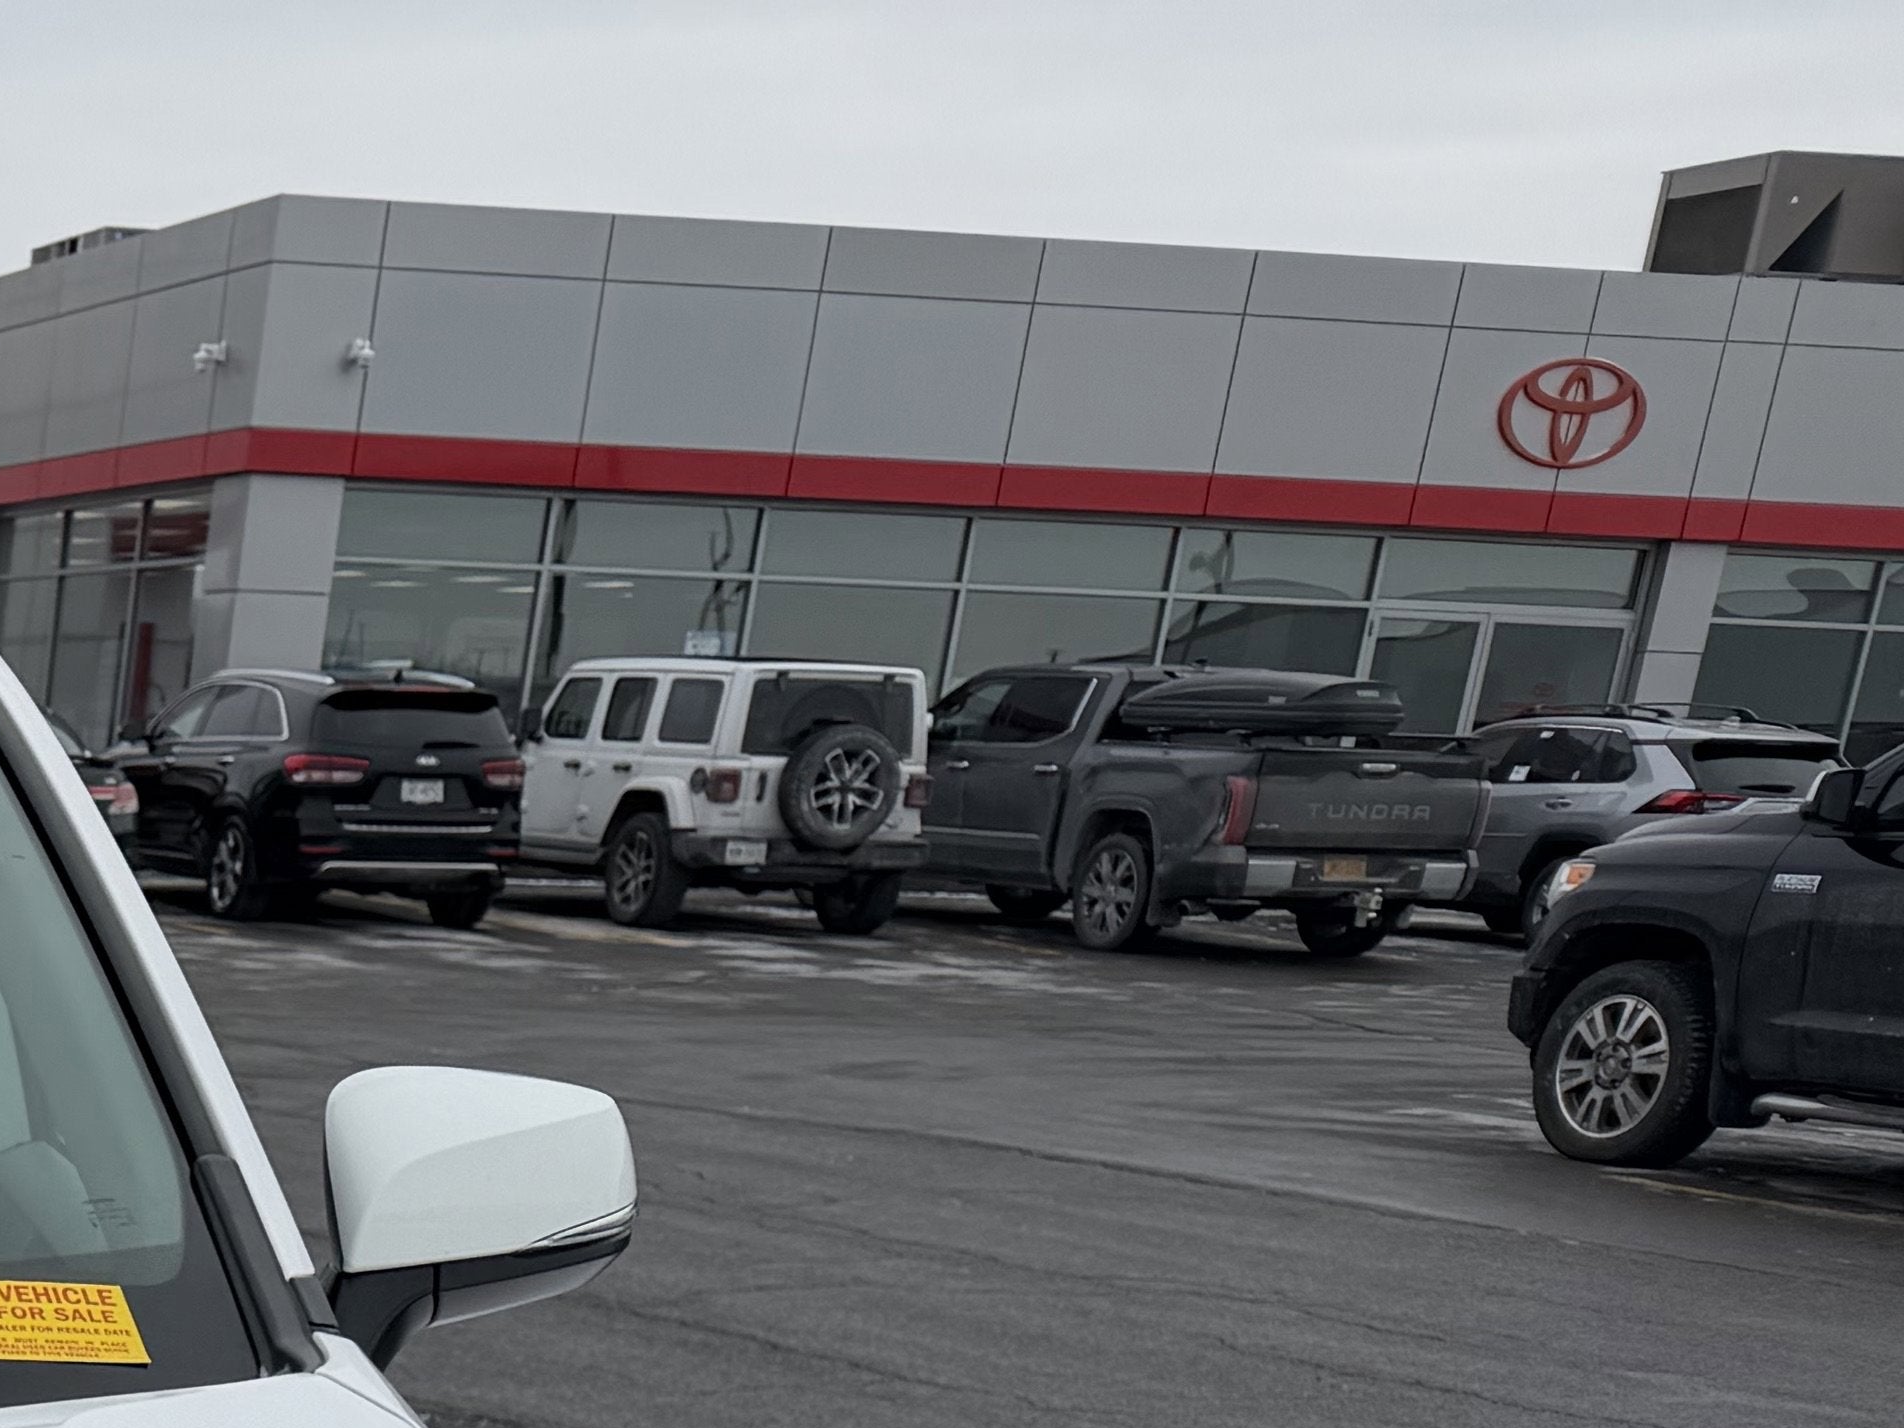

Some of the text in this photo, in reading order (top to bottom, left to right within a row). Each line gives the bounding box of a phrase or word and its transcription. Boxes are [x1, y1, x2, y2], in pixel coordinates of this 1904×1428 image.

[1307, 801, 1431, 821] TUNDRA
[50, 1307, 118, 1323] SALE
[29, 1325, 54, 1333] FOR
[55, 1326, 101, 1335] RESALE
[102, 1328, 132, 1336] DATE
